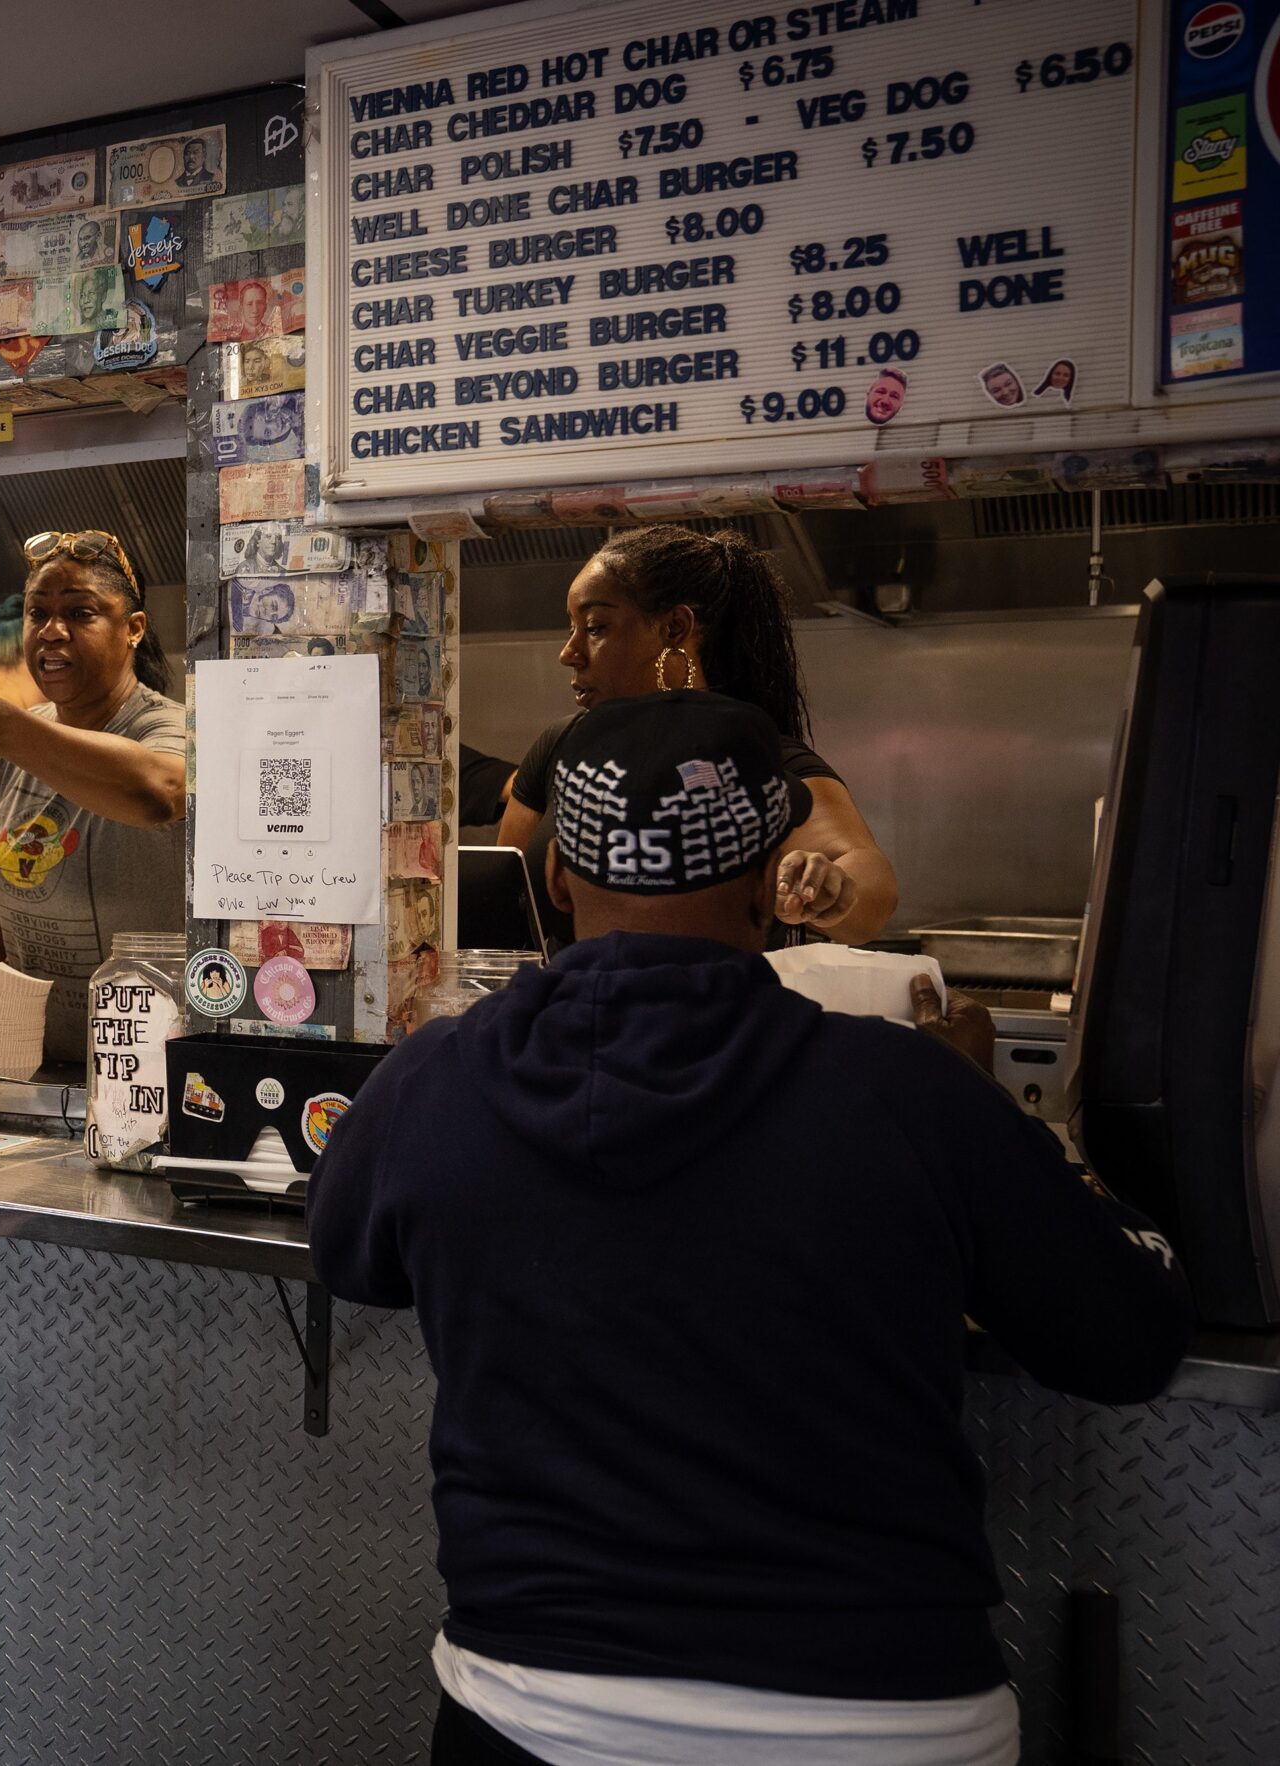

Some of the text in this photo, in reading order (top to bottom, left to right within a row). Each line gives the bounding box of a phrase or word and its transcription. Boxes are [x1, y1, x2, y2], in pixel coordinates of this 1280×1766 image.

[1188, 19, 1241, 42] PEPSI
[349, 0, 918, 123] VIENNA RED HOT CHAR OR STEAM
[350, 120, 433, 159] CHAR
[447, 90, 595, 142] CHEDDAR
[614, 74, 687, 115] DOG
[351, 163, 433, 202] CHAR
[460, 139, 572, 185] POLISH
[618, 118, 703, 159] $7.50
[797, 89, 867, 130] VEG
[886, 71, 969, 116] DOG
[1014, 41, 1132, 93] $6.50
[1182, 136, 1237, 164] Starry
[119, 163, 142, 180] 1000
[353, 120, 975, 245] WELL DONE CHAR BURGER $7.50
[1174, 202, 1239, 227] CAFFEINE
[1190, 217, 1223, 236] FREE
[128, 232, 183, 268] Jersey's
[351, 203, 764, 287] CHEESE BURGER $8.00
[957, 226, 1064, 268] WELL
[1177, 243, 1237, 279] MUG
[352, 233, 889, 330] CHAR TURKEY BURGER $8.25
[959, 268, 1064, 312] DONE
[353, 282, 901, 373] CHAR VEGGIE BURGER $8.00
[1177, 339, 1234, 358] Tropicana
[353, 381, 436, 416] CHAR
[454, 365, 578, 406] BEYOND
[598, 348, 739, 392] BURGER
[351, 386, 846, 459] CHICKEN SANDWICH $9.00
[217, 440, 238, 460] 10
[234, 637, 250, 648] 1000
[266, 824, 304, 834] venmo
[606, 828, 672, 874] 25
[211, 864, 357, 886] Please Tip Our Crew
[3, 883, 48, 902] CIRCLE
[35, 931, 67, 946] DOGS
[219, 954, 241, 982] SMOKE
[96, 982, 155, 1012] PUT
[194, 994, 239, 1011] ACCESSORIES
[92, 1018, 149, 1045] THE
[94, 1052, 138, 1080] TIP
[129, 1085, 164, 1114] IN
